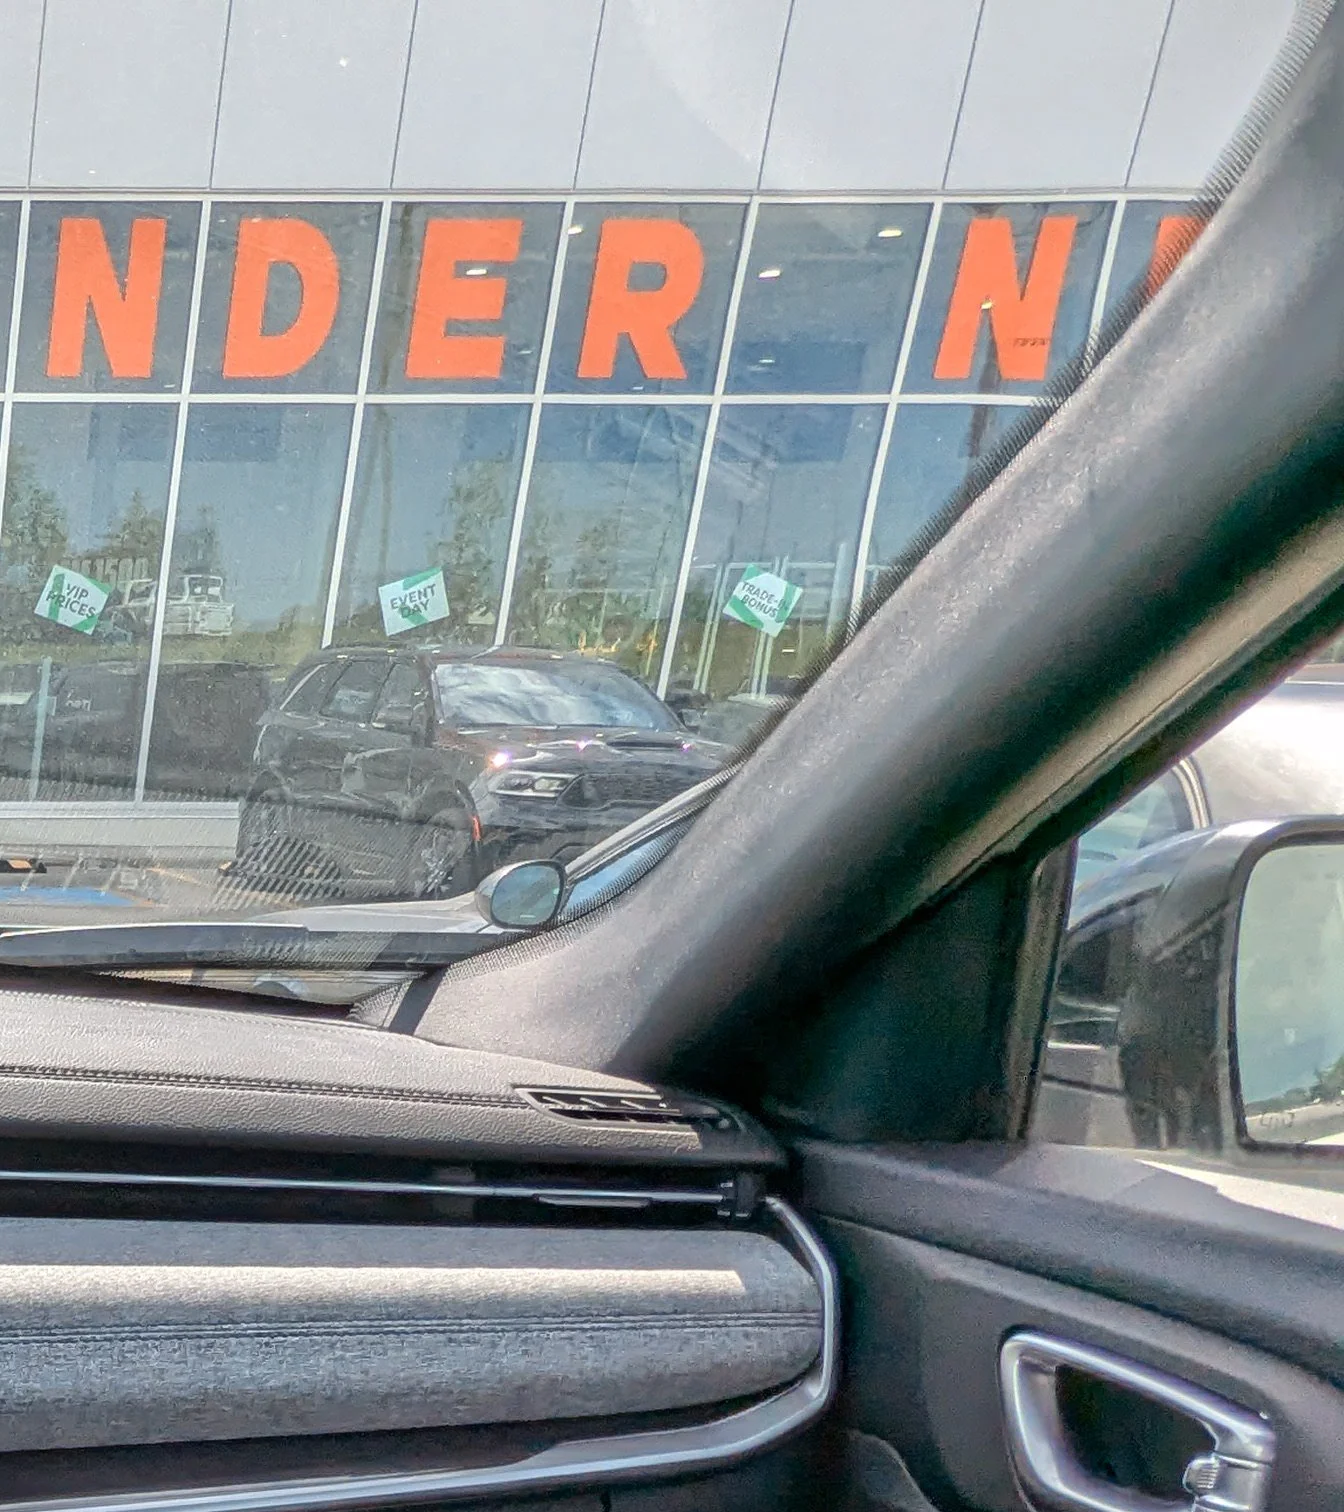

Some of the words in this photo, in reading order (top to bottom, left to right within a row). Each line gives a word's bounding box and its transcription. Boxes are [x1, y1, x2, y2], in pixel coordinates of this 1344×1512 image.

[66, 583, 89, 600] VIP
[390, 584, 436, 609] EVENT
[46, 590, 96, 618] PRICES
[401, 599, 430, 618] DAY
[741, 594, 778, 618] BONUS
